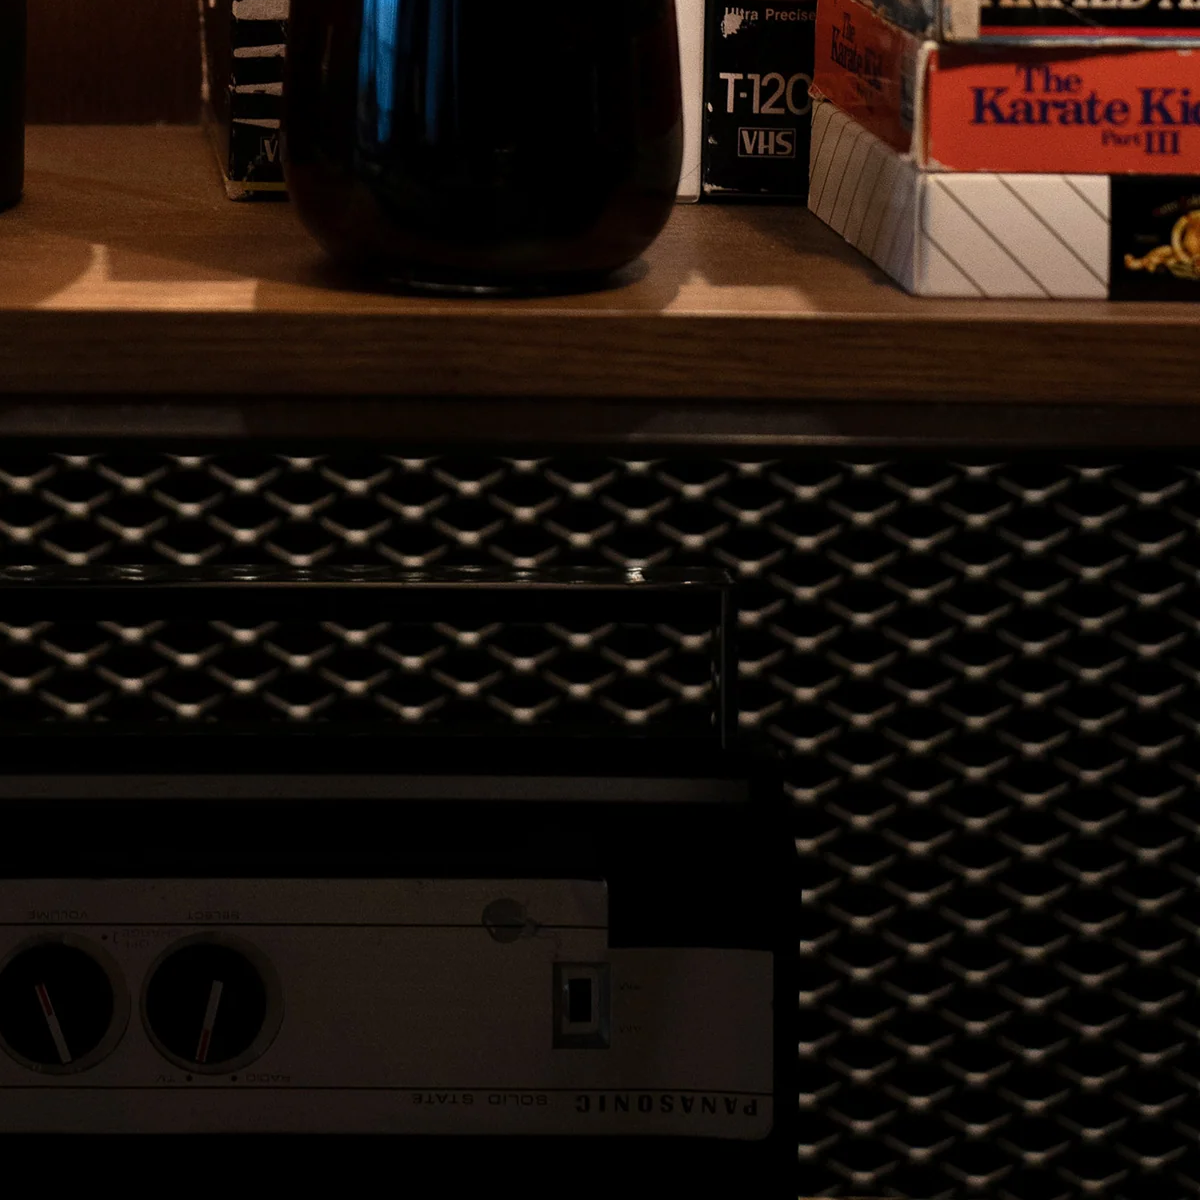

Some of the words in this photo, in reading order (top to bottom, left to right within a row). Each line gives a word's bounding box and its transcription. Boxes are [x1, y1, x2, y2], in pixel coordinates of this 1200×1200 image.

[1016, 63, 1081, 93] The
[719, 72, 813, 115] T-120
[970, 86, 1130, 126] Karate
[741, 130, 793, 155] VHS
[1101, 130, 1140, 146] Part
[1144, 130, 1179, 155] III
[29, 910, 89, 920] VOLUME
[186, 910, 241, 920] SELECT
[245, 1073, 291, 1083] RADIO
[412, 1092, 474, 1106] STATE
[487, 1093, 548, 1106] SOLID
[575, 1094, 758, 1116] PANASONIC
